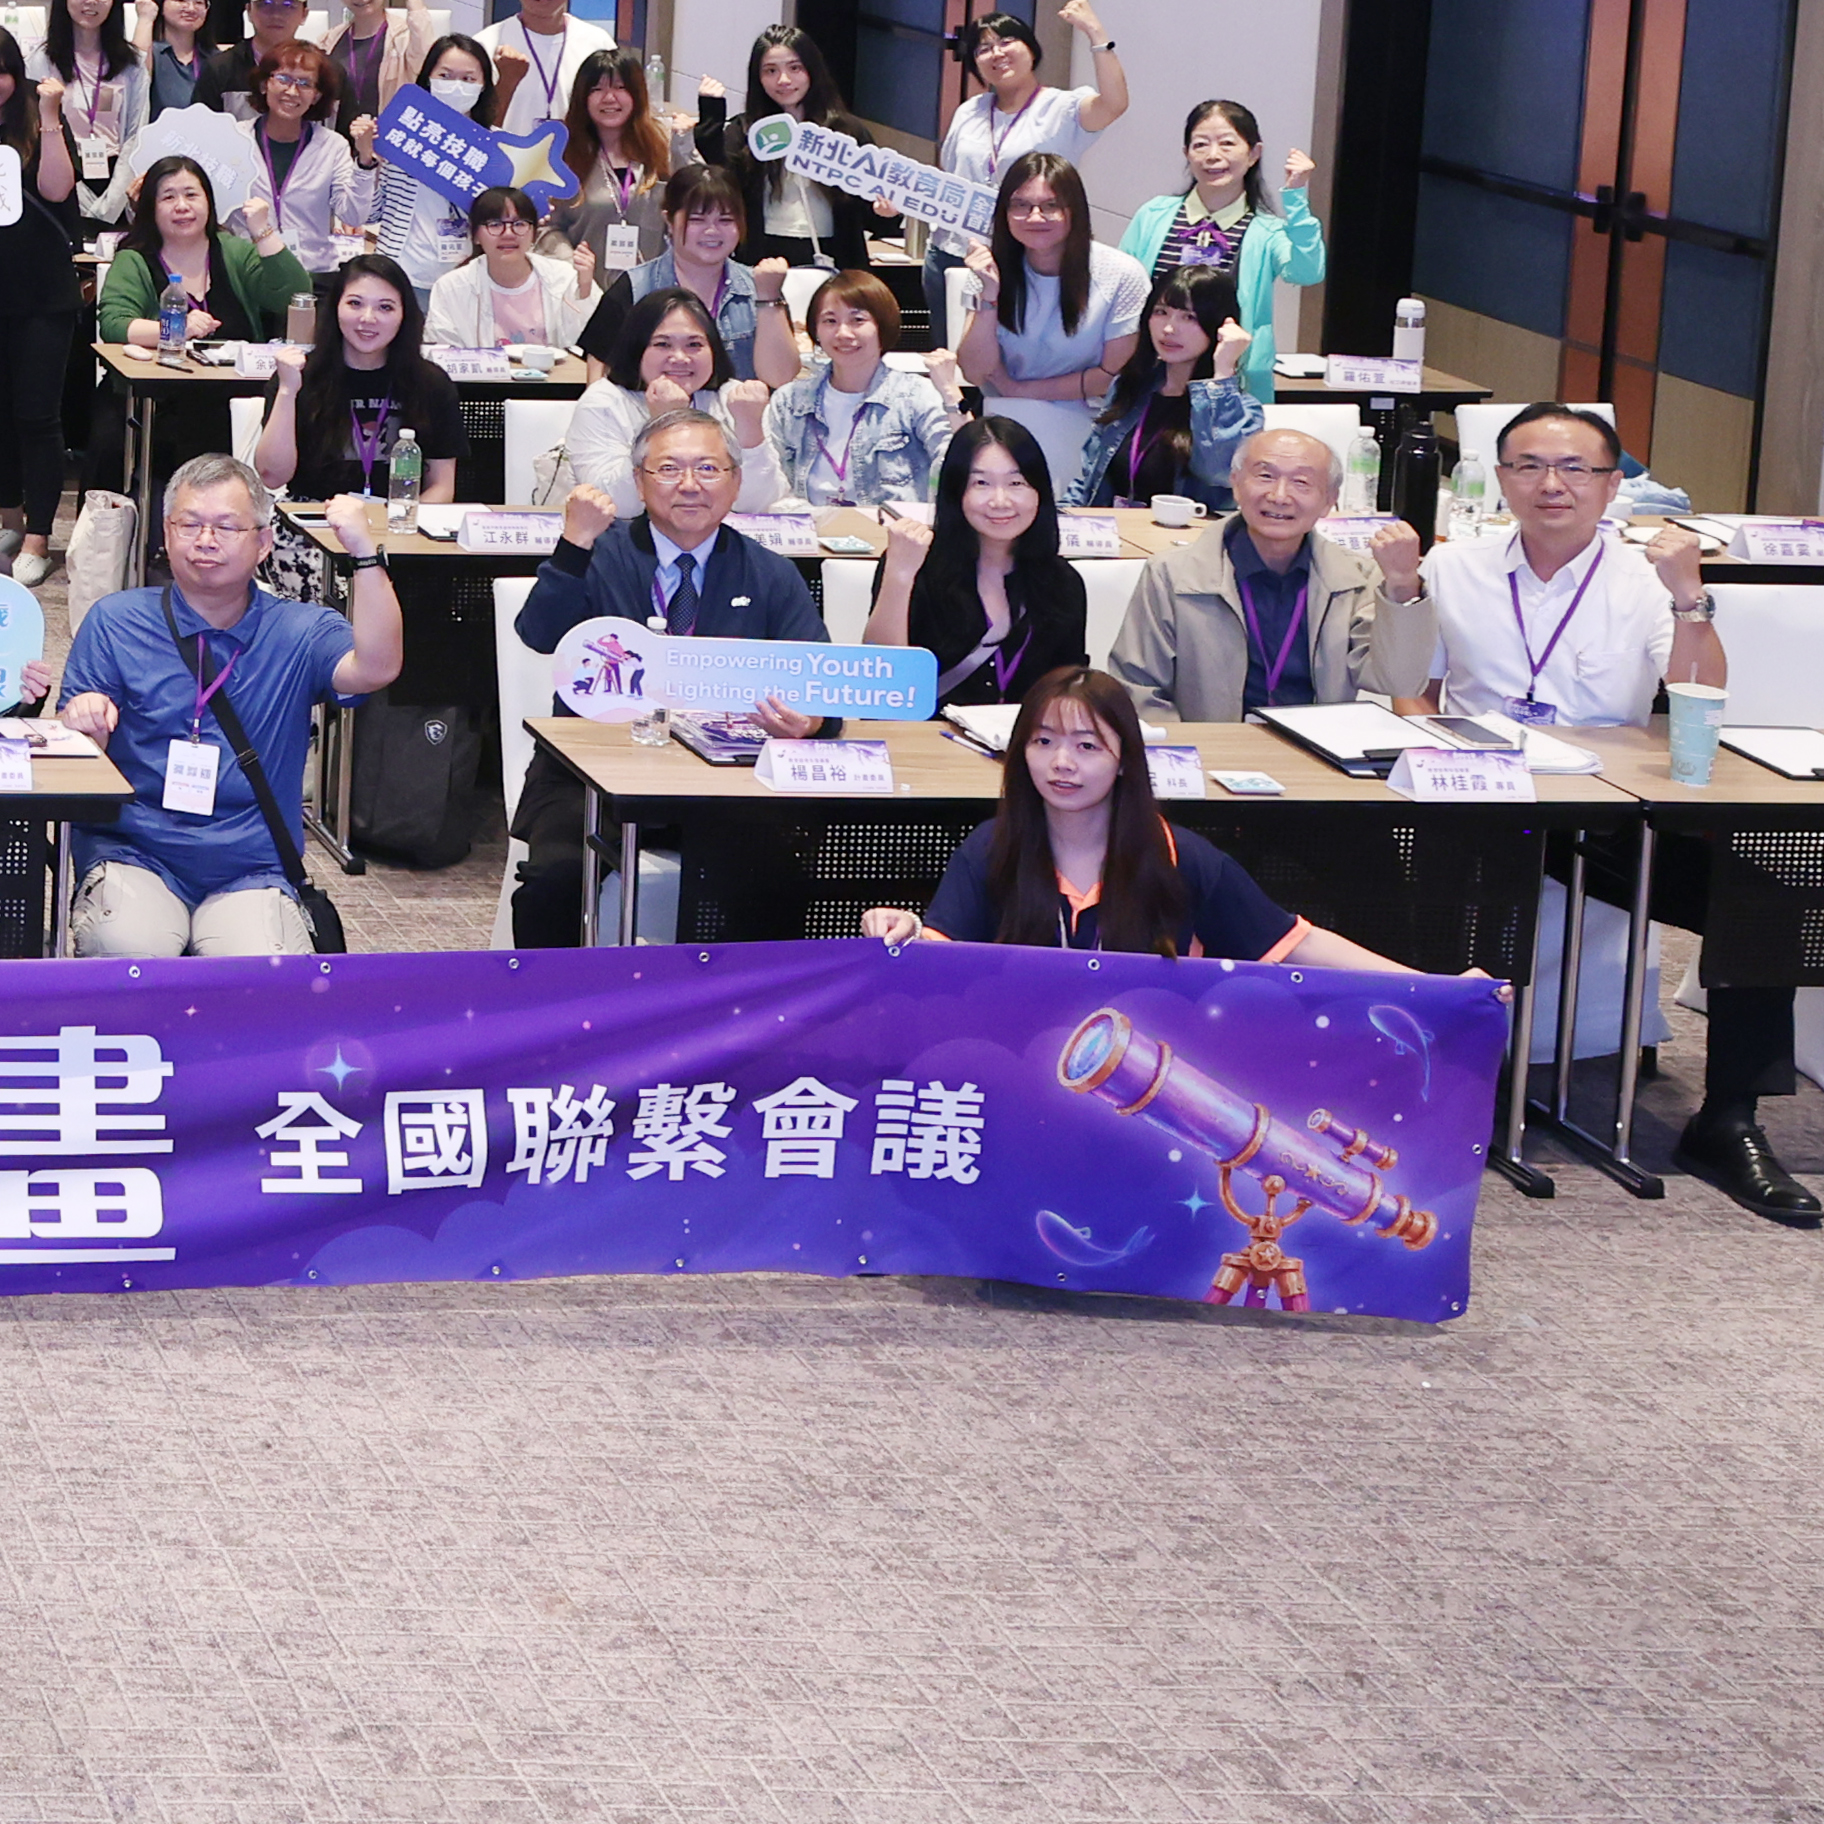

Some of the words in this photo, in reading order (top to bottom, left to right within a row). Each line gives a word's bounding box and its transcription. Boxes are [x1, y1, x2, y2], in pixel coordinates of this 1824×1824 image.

[398, 105, 489, 174] 點亮技職
[384, 128, 490, 198] 成就每個孩子
[792, 155, 861, 189] NTPC
[484, 531, 528, 544] 江永群
[665, 648, 803, 677] Empowering
[806, 651, 894, 679] Youth
[665, 679, 757, 706] Lighting
[762, 684, 801, 704] the
[804, 681, 917, 709] Future!
[790, 764, 847, 782] 楊昌裕
[1431, 774, 1488, 792] 林桂霞
[254, 1076, 987, 1195] 全國聯繫會議
